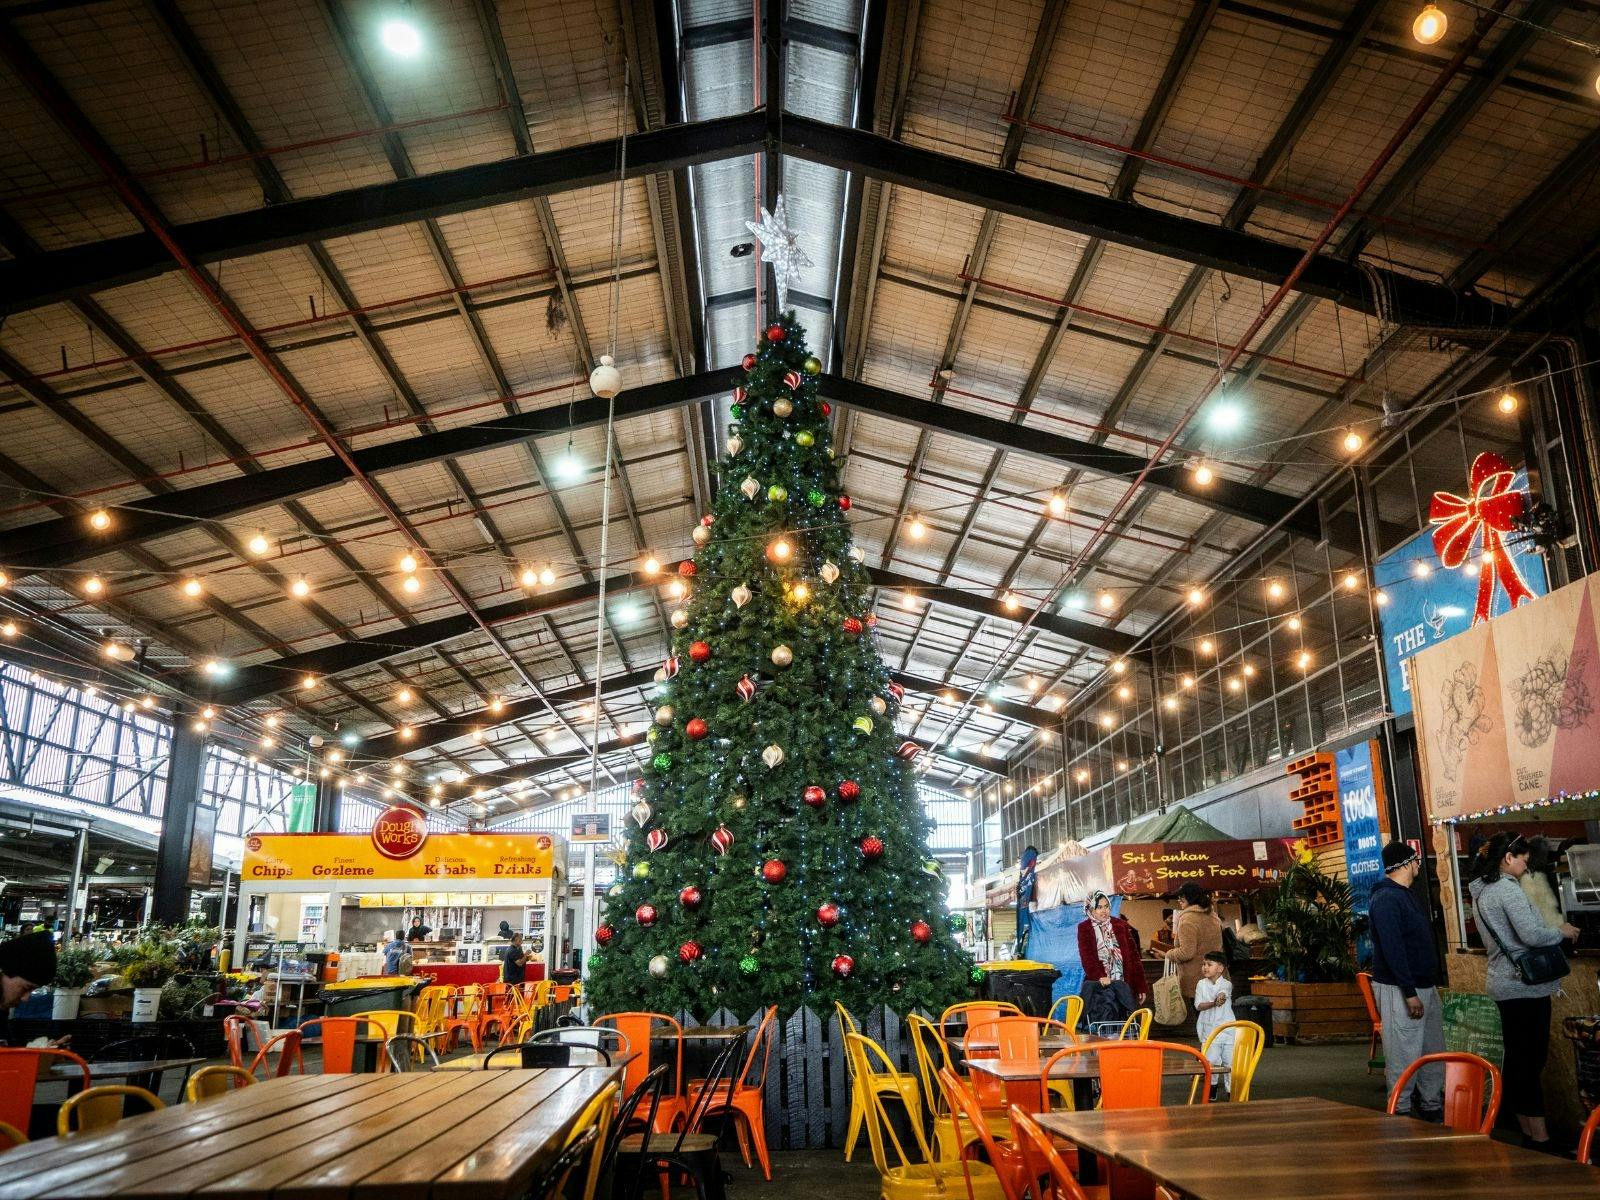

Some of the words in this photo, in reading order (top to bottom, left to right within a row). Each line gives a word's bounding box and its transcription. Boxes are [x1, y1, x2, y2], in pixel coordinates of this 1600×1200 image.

[1394, 623, 1425, 656] THE
[1518, 780, 1543, 792] CANE.
[1121, 852, 1147, 864] Sri
[1150, 850, 1210, 862] Lankan
[252, 864, 294, 879] Chips
[312, 864, 375, 876] Gozleme
[424, 864, 476, 875] Kebabs
[493, 863, 542, 875] Drinks
[1156, 867, 1205, 879] Street
[1208, 864, 1247, 877] Food
[1350, 859, 1380, 874] CLOTHES
